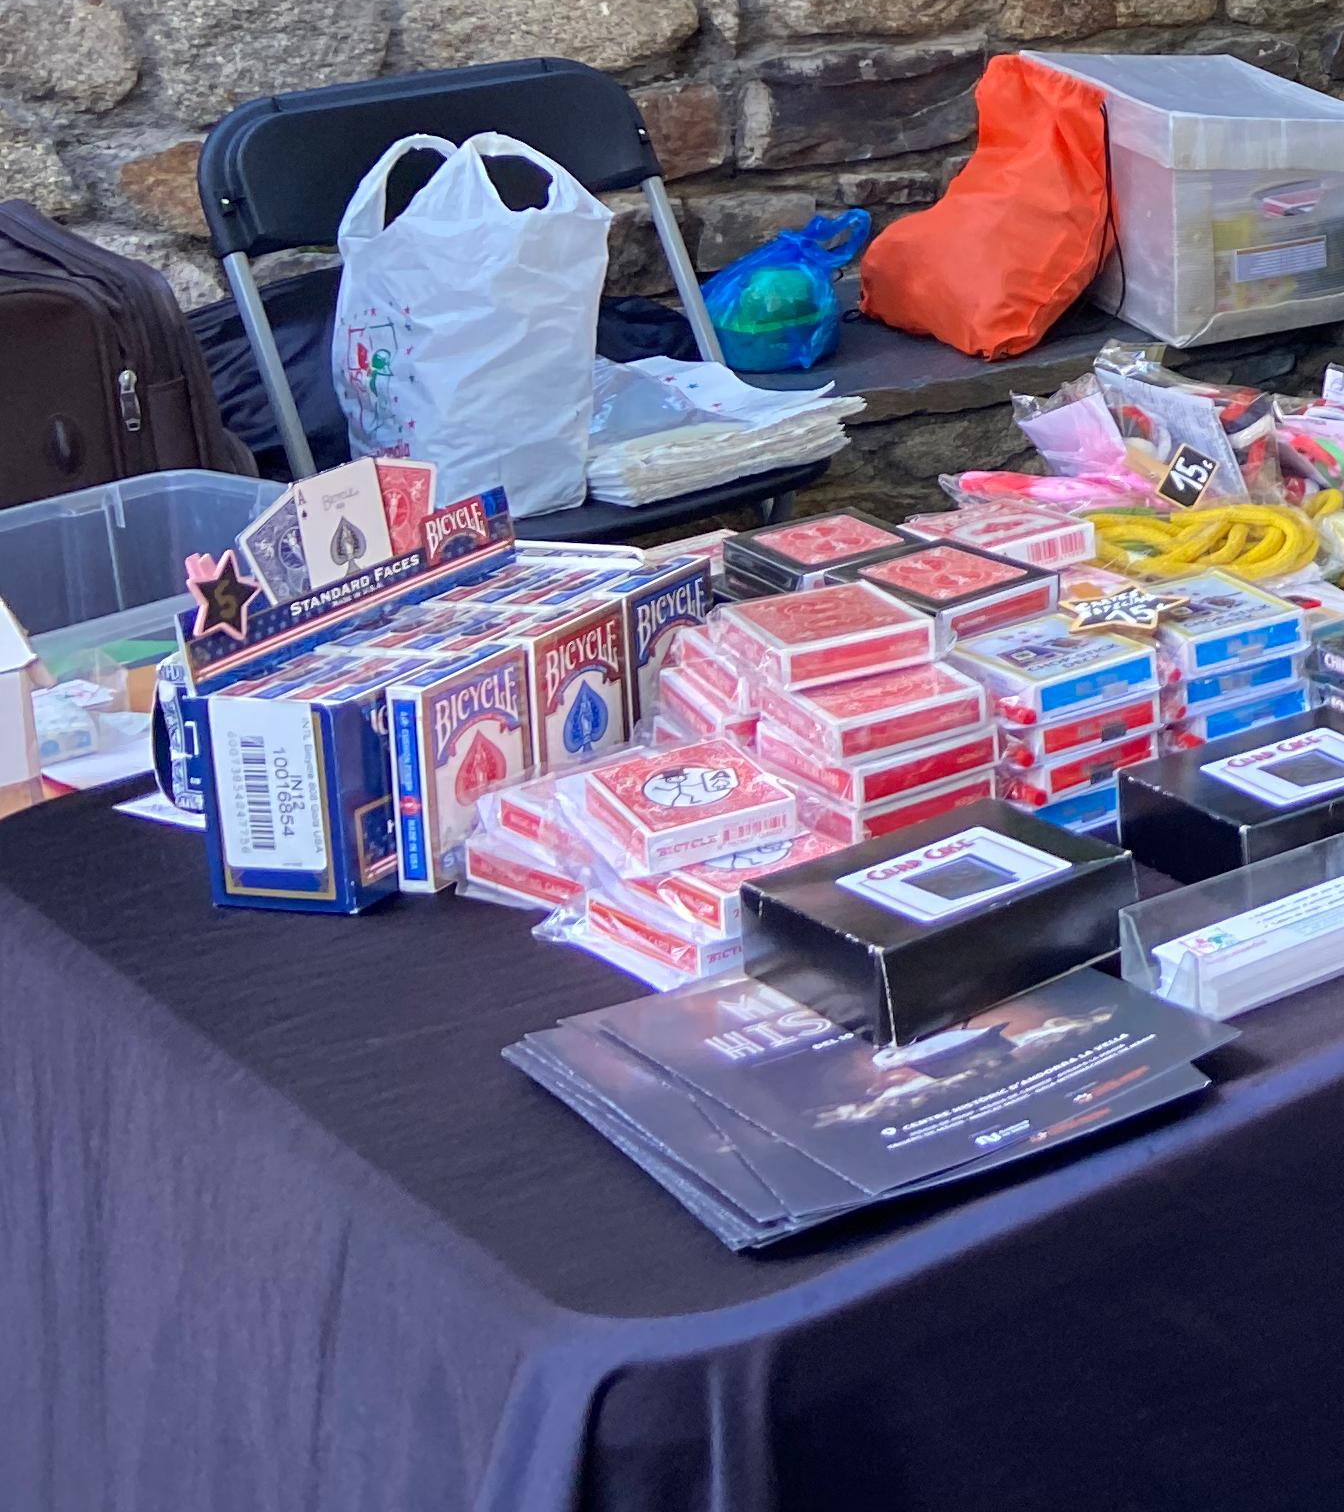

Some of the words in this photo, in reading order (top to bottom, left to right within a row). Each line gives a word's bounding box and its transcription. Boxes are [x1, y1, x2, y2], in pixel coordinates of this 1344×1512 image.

[425, 502, 487, 560] BICYCLE
[290, 574, 372, 617] STANDARD
[374, 553, 420, 583] FACES
[635, 576, 706, 661] BICYCLE
[545, 618, 620, 707] BICYCLE
[434, 665, 519, 762] BICYCLE
[272, 746, 295, 838] 10016854
[290, 774, 305, 811] IN12
